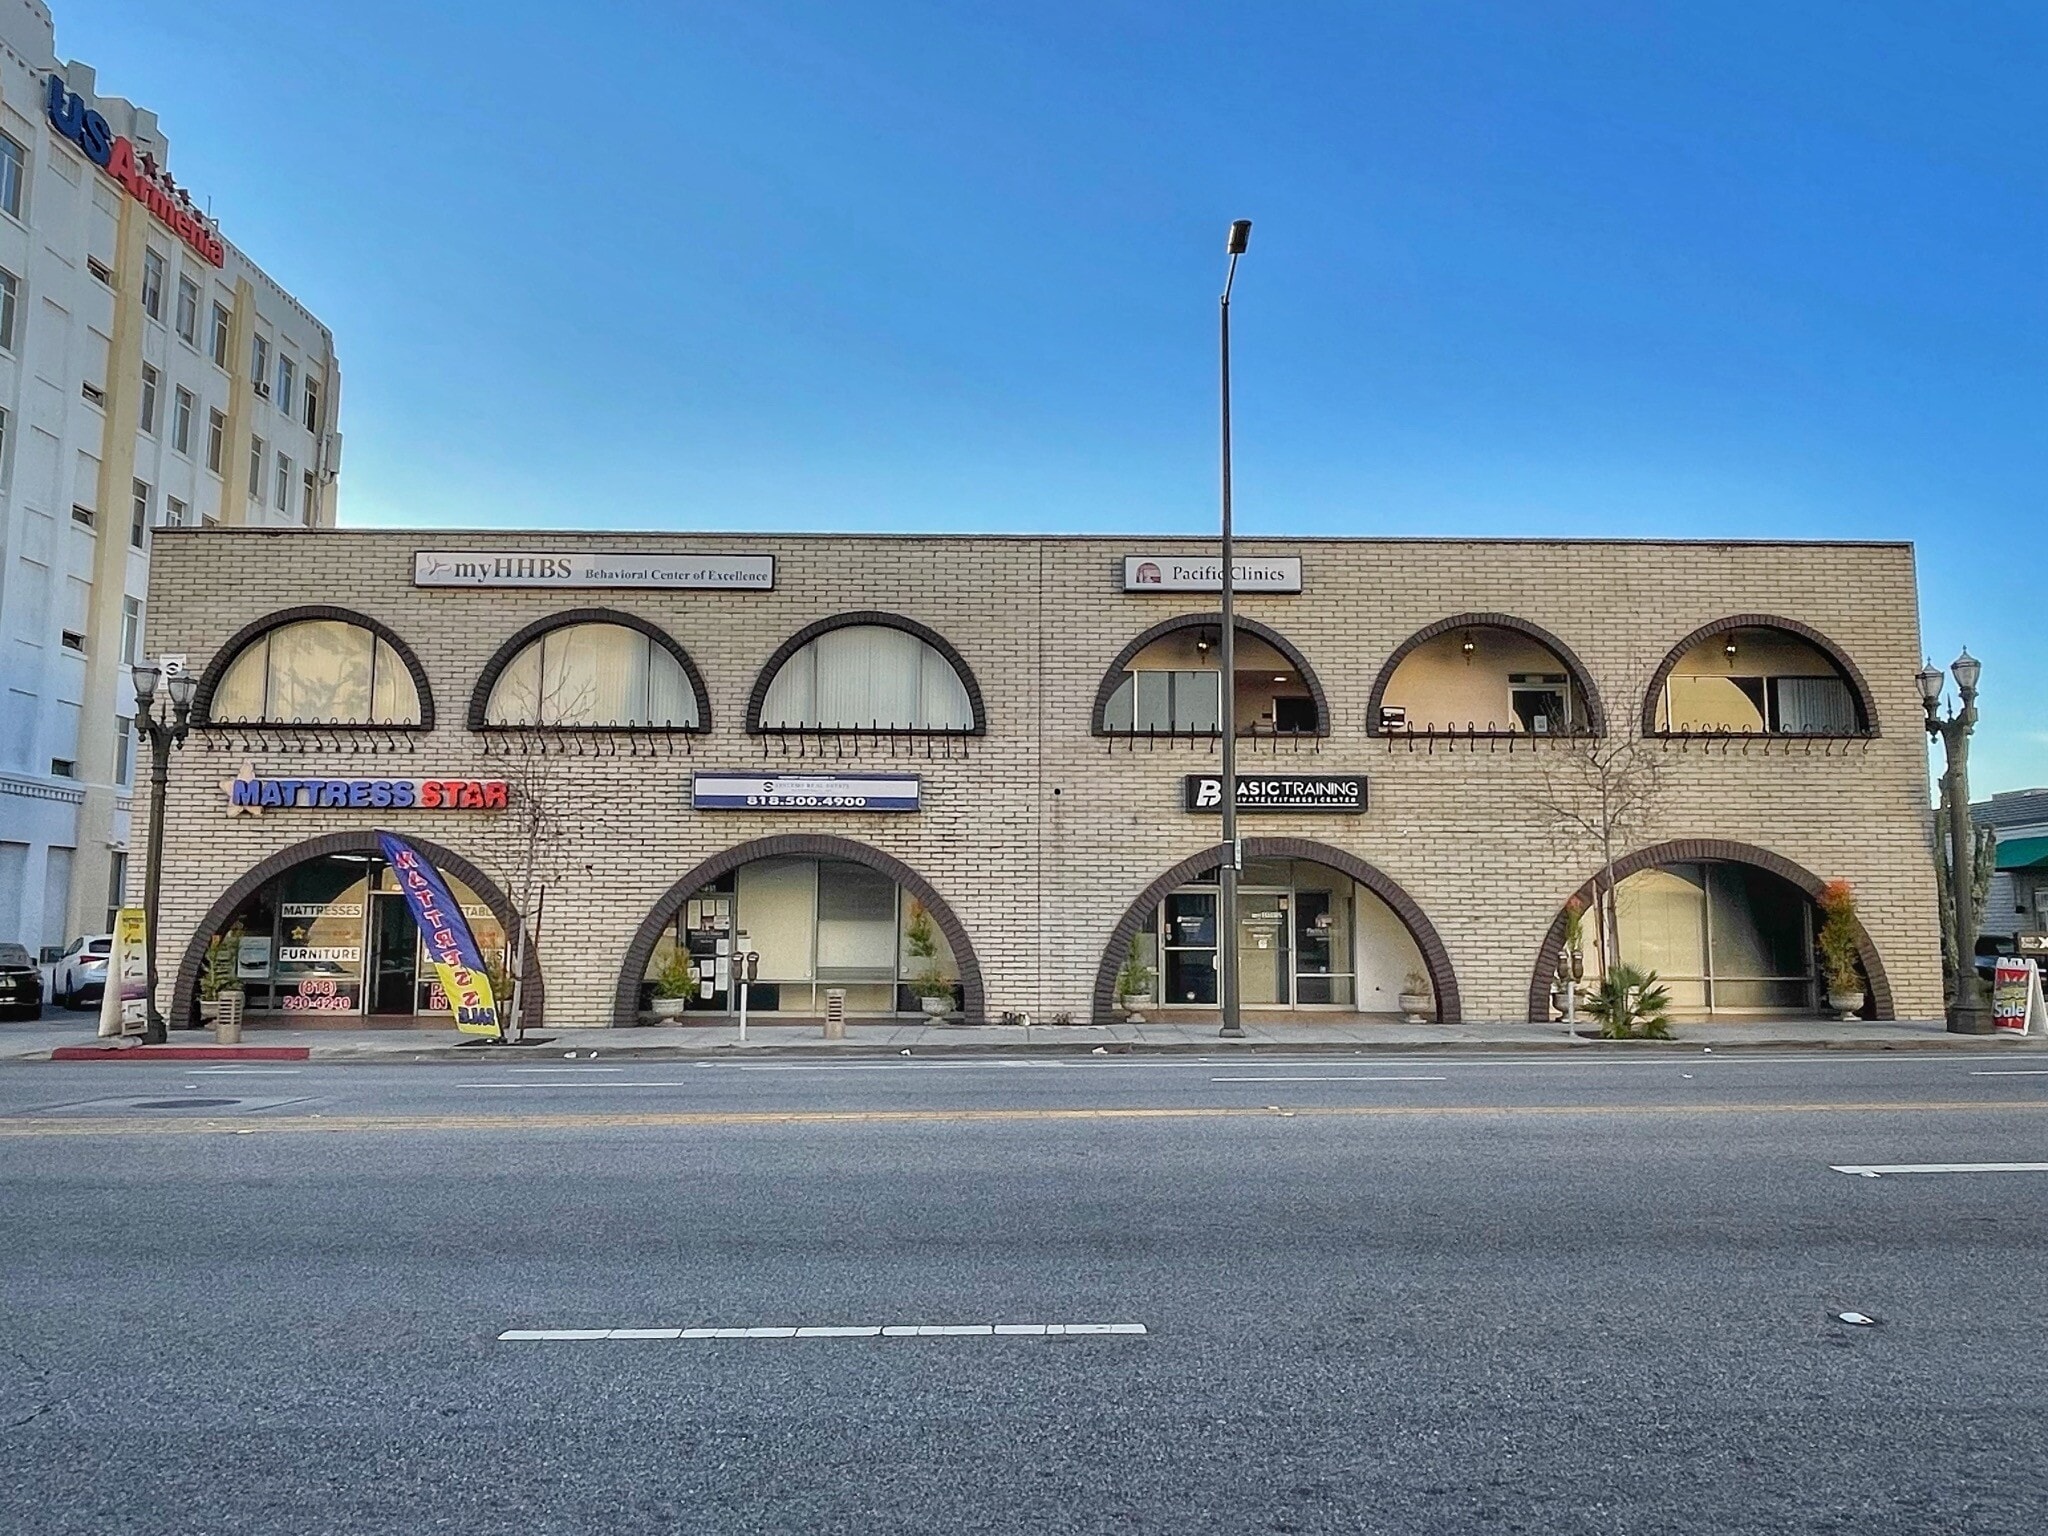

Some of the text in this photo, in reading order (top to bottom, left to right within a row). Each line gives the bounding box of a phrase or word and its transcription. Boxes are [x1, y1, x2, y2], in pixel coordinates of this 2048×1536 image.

[454, 558, 768, 583] myHHBS Behavioral Center of Excellence
[1172, 566, 1285, 581] Pacific Clinics
[232, 780, 508, 809] MATTRESS STAR
[1281, 782, 1358, 796] TRAINING
[746, 796, 866, 806] 818.500.4900
[283, 905, 360, 916] MATTRESSES
[281, 949, 359, 960] FURNITURE
[299, 980, 337, 997] (818)
[283, 996, 351, 1009] 240-4240
[1993, 1000, 2025, 1018] Sale
